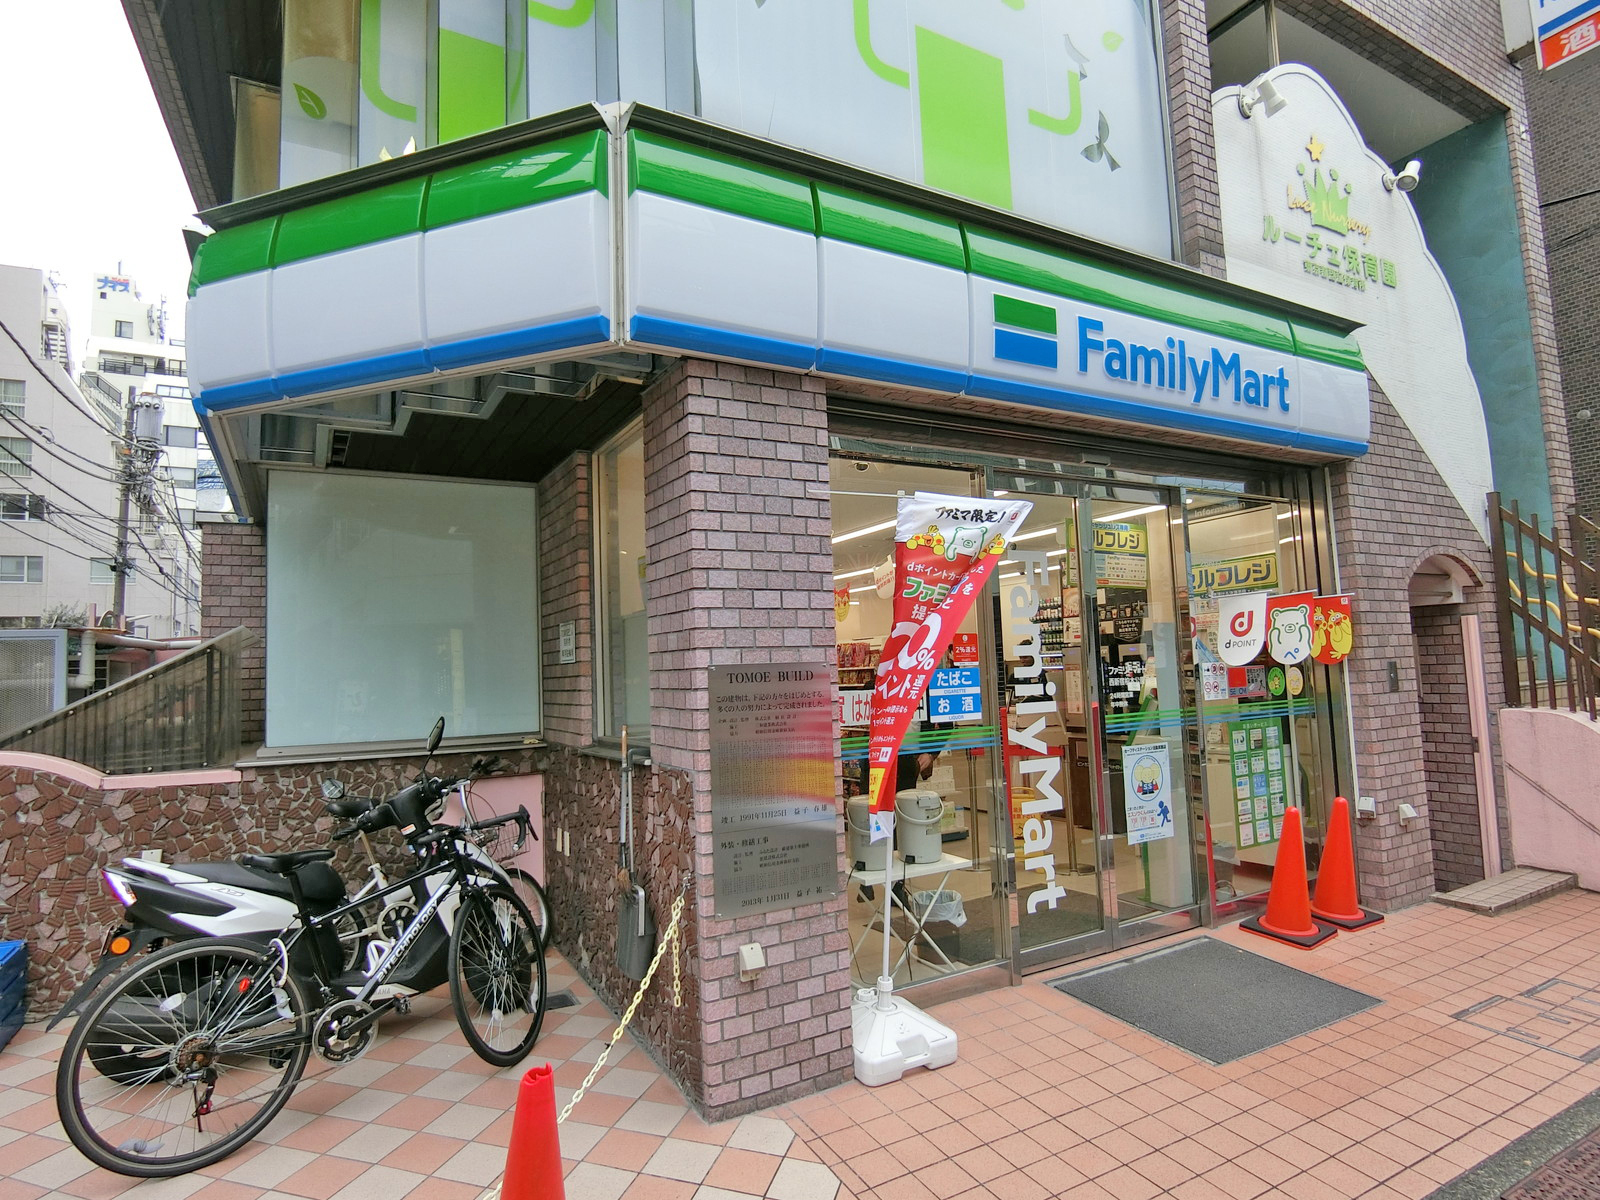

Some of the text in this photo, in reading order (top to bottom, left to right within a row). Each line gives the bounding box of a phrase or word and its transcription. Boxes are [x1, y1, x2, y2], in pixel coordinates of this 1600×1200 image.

[1560, 20, 1600, 57] 酒
[1076, 314, 1290, 414] FamilyMart
[1194, 501, 1246, 518] Information
[727, 670, 814, 684] TOMOE BUILD
[936, 671, 972, 686] たばこ
[1007, 550, 1067, 914] FamilyMart
[1143, 783, 1153, 791] SS
